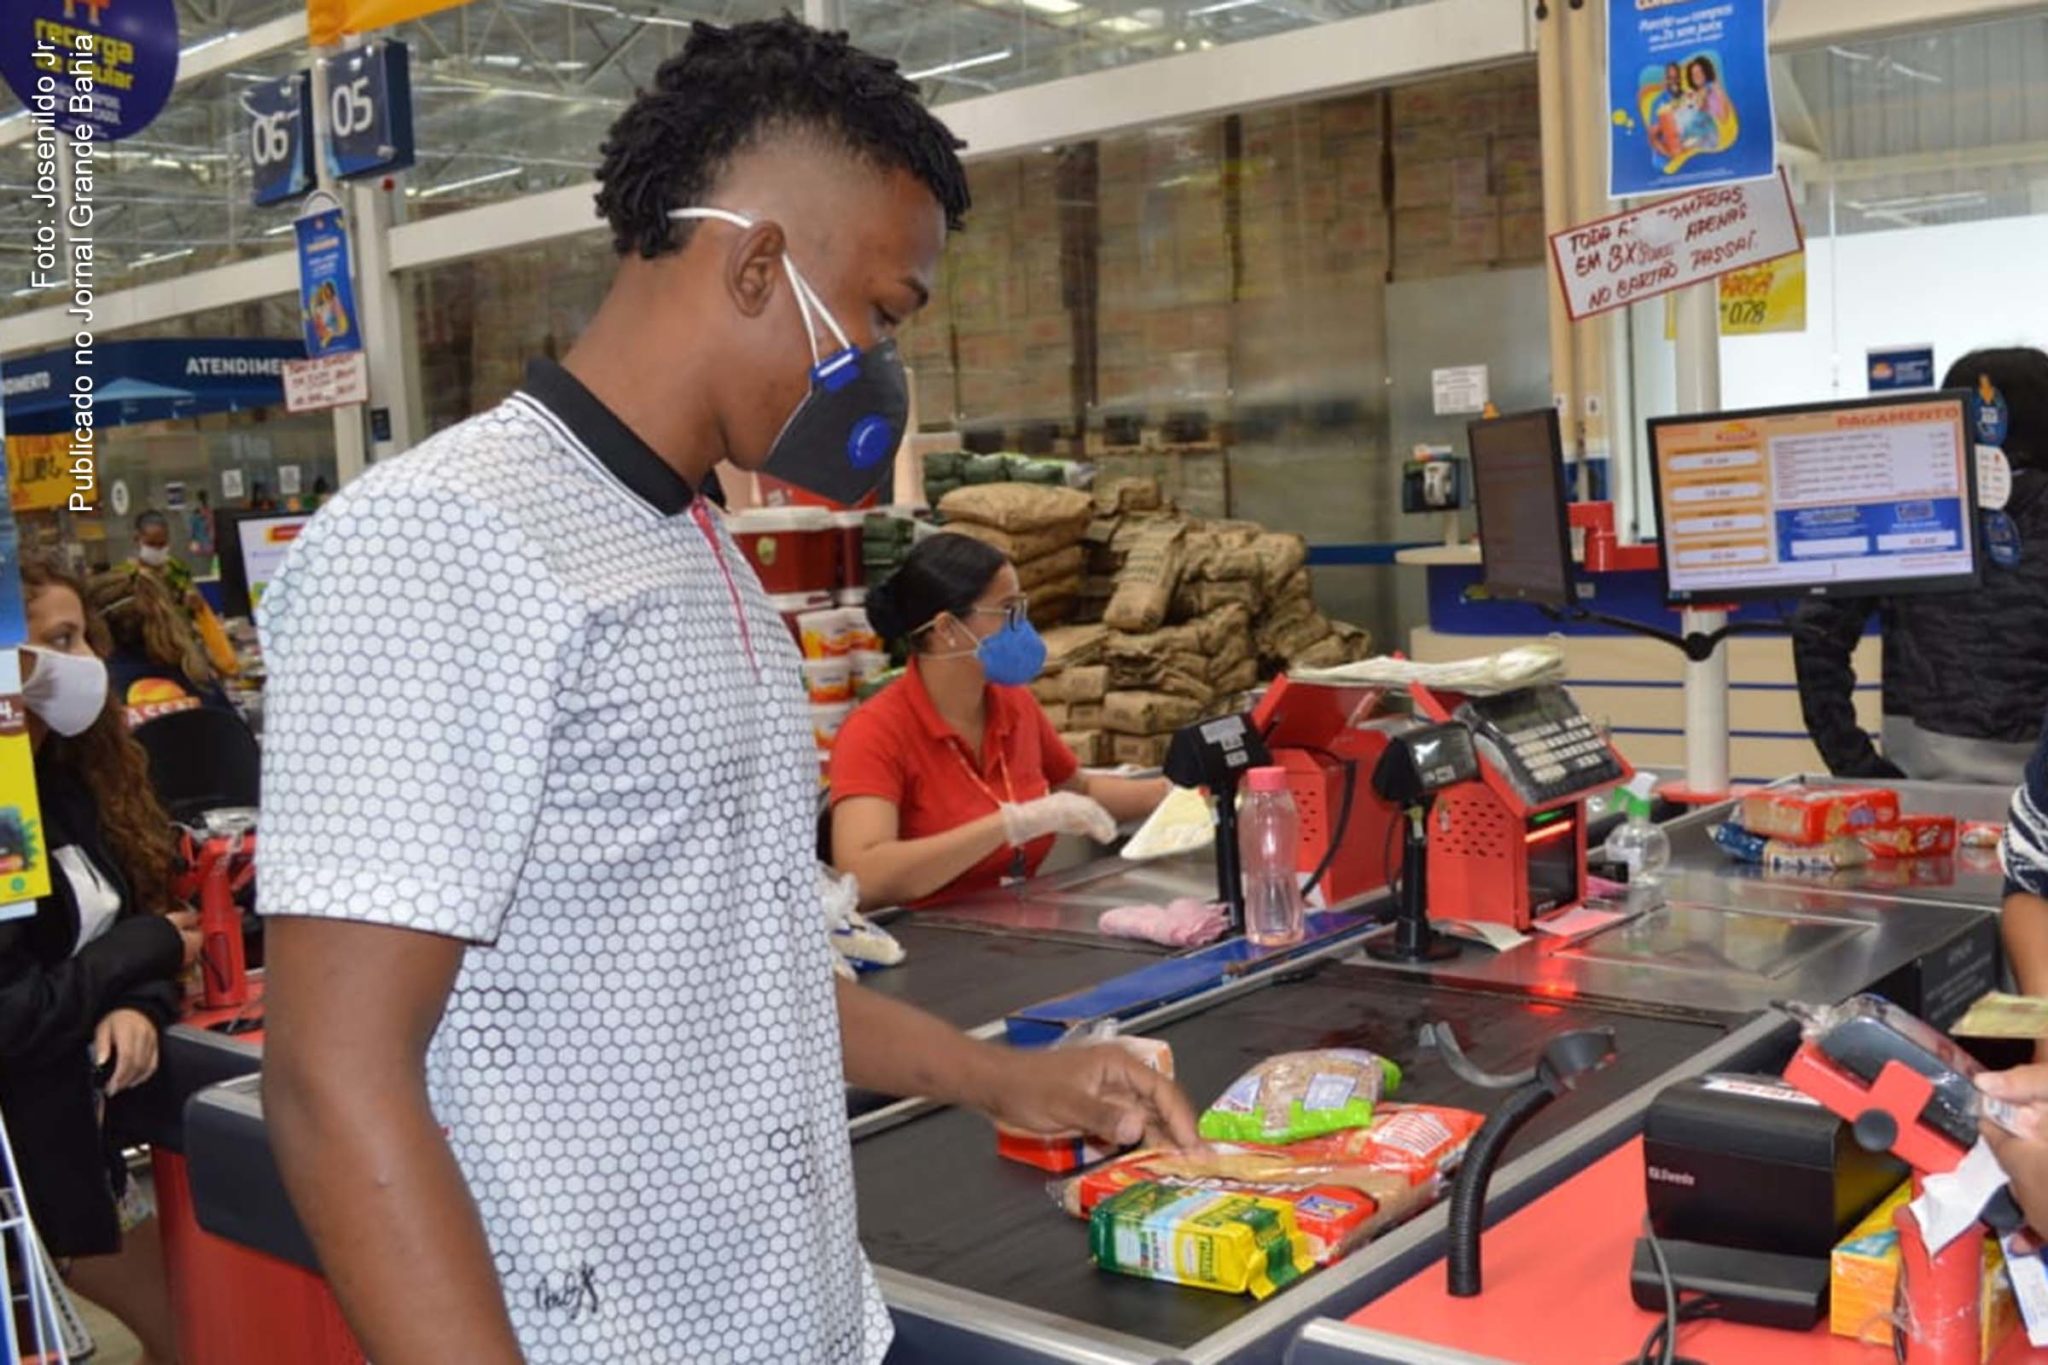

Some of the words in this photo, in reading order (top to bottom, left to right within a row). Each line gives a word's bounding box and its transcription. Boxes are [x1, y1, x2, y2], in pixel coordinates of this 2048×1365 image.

[331, 75, 374, 138] 05
[252, 110, 290, 166] 06
[186, 356, 284, 376] ATENDIME
[1836, 405, 1960, 429] PAGAMENTO
